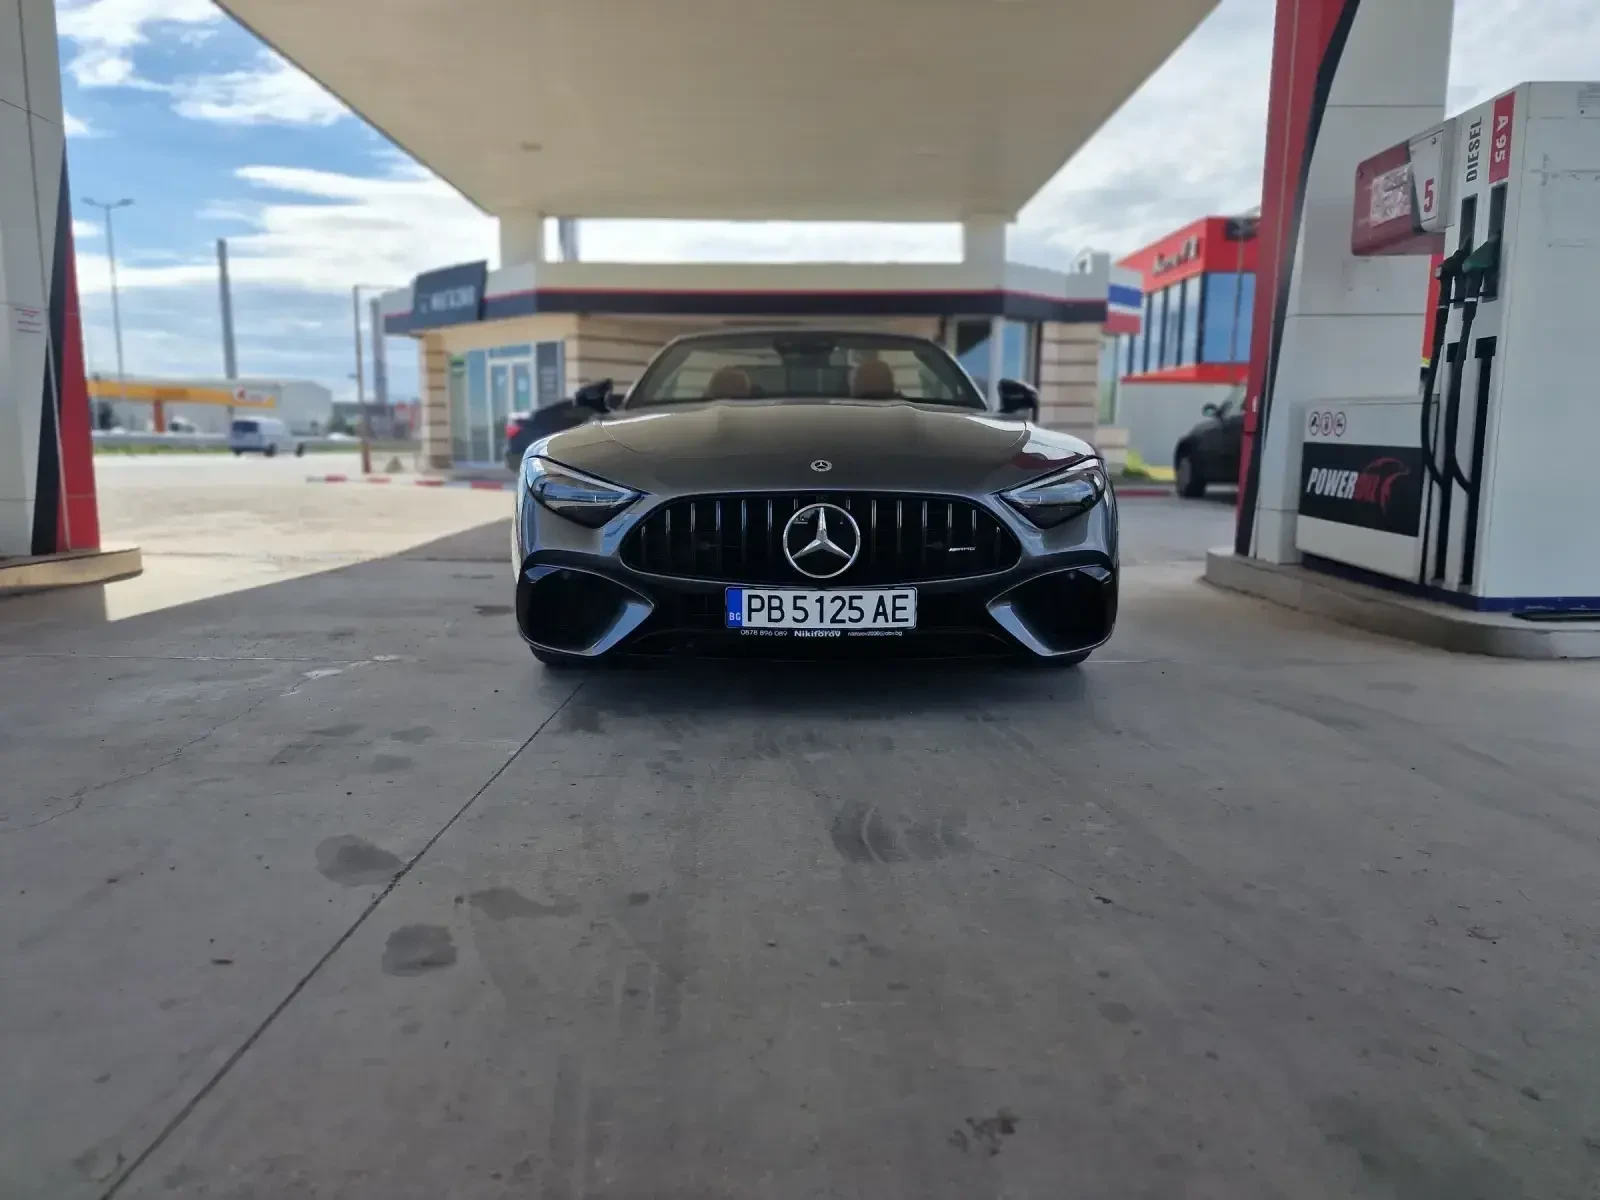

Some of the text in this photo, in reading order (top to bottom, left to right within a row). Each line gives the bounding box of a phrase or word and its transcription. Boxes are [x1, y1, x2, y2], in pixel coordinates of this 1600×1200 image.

[1466, 116, 1482, 183] DIESEL
[1495, 115, 1509, 163] A 95
[1424, 177, 1434, 213] 5
[1306, 467, 1380, 503] POWER
[729, 612, 741, 621] BG
[747, 594, 909, 624] PB 5125 AE
[794, 629, 841, 638] Nikiforov
